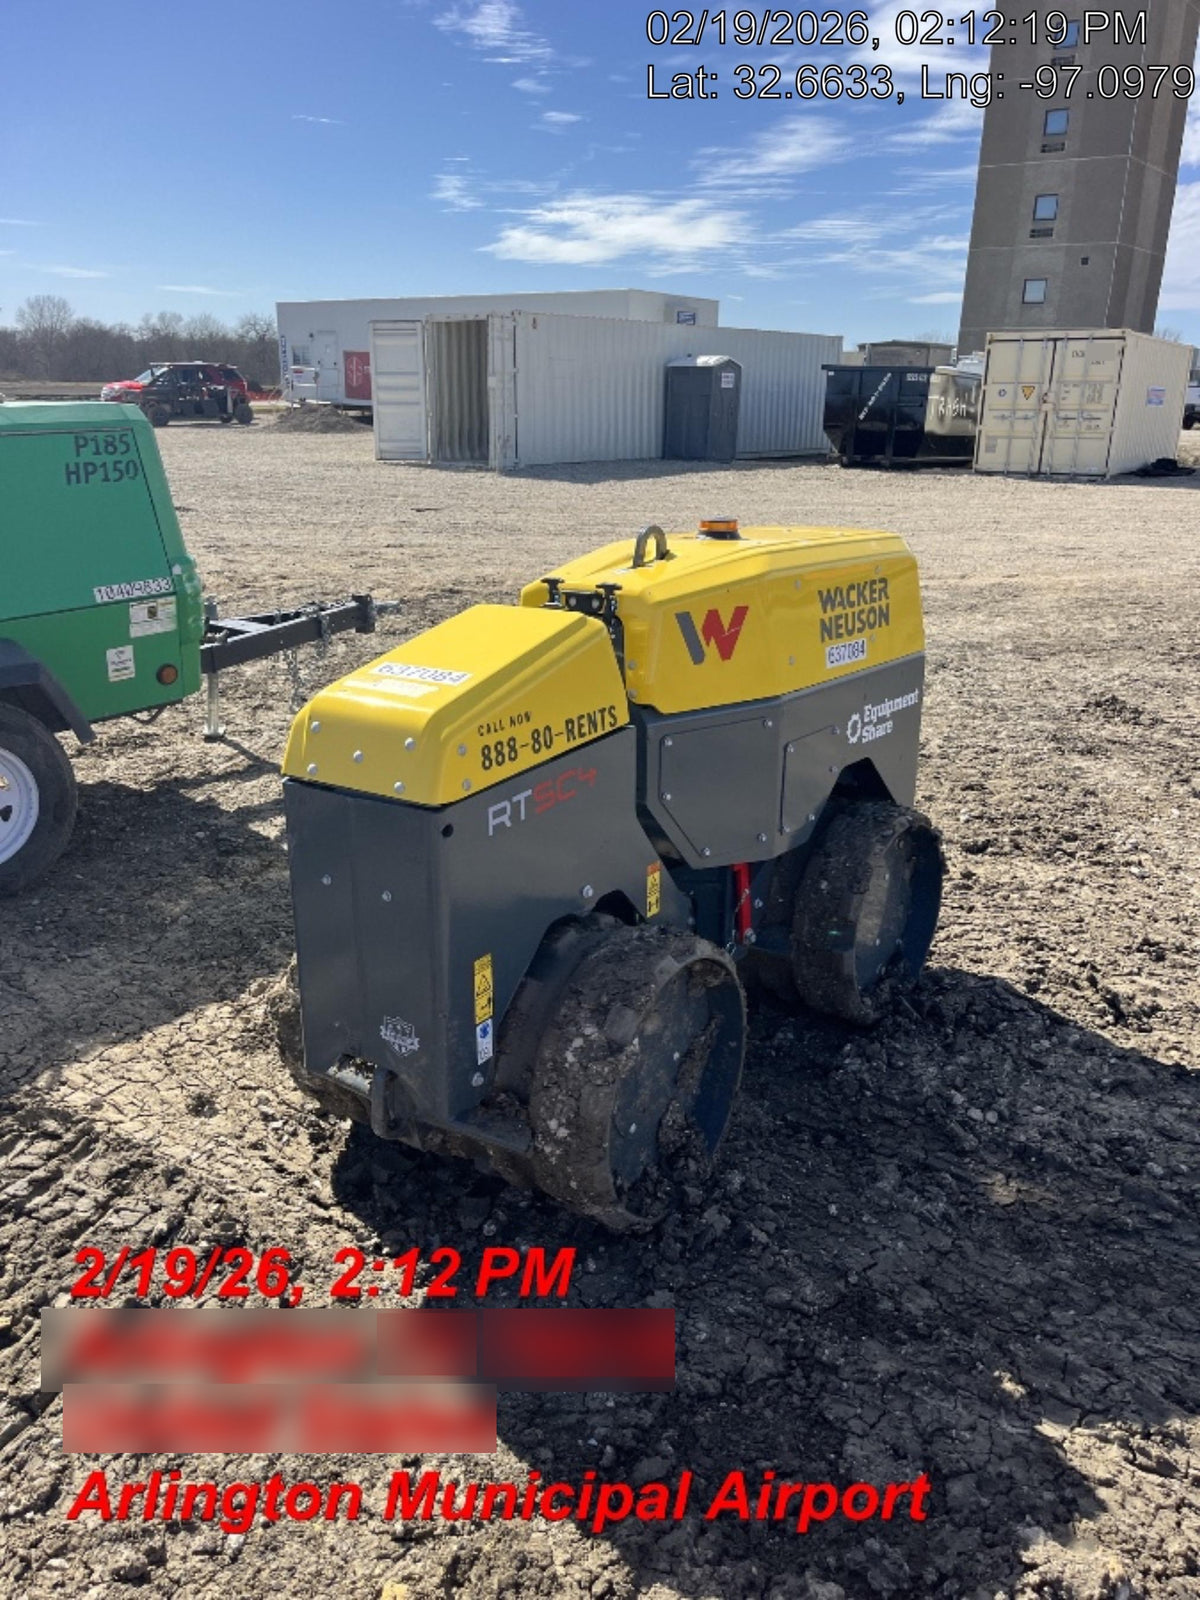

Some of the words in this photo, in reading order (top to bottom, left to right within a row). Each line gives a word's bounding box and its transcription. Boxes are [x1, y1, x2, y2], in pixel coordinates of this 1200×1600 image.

[74, 433, 131, 457] P185
[65, 459, 139, 485] HP150
[818, 576, 890, 614] WACKER
[820, 603, 890, 643] NEUSON
[827, 640, 866, 666] 637084
[378, 664, 468, 682] 637084
[863, 688, 920, 724] Equipment
[478, 719, 505, 737] CALL
[510, 711, 533, 727] NOW
[861, 719, 893, 744] Share
[481, 705, 619, 770] 888-80-RENTS
